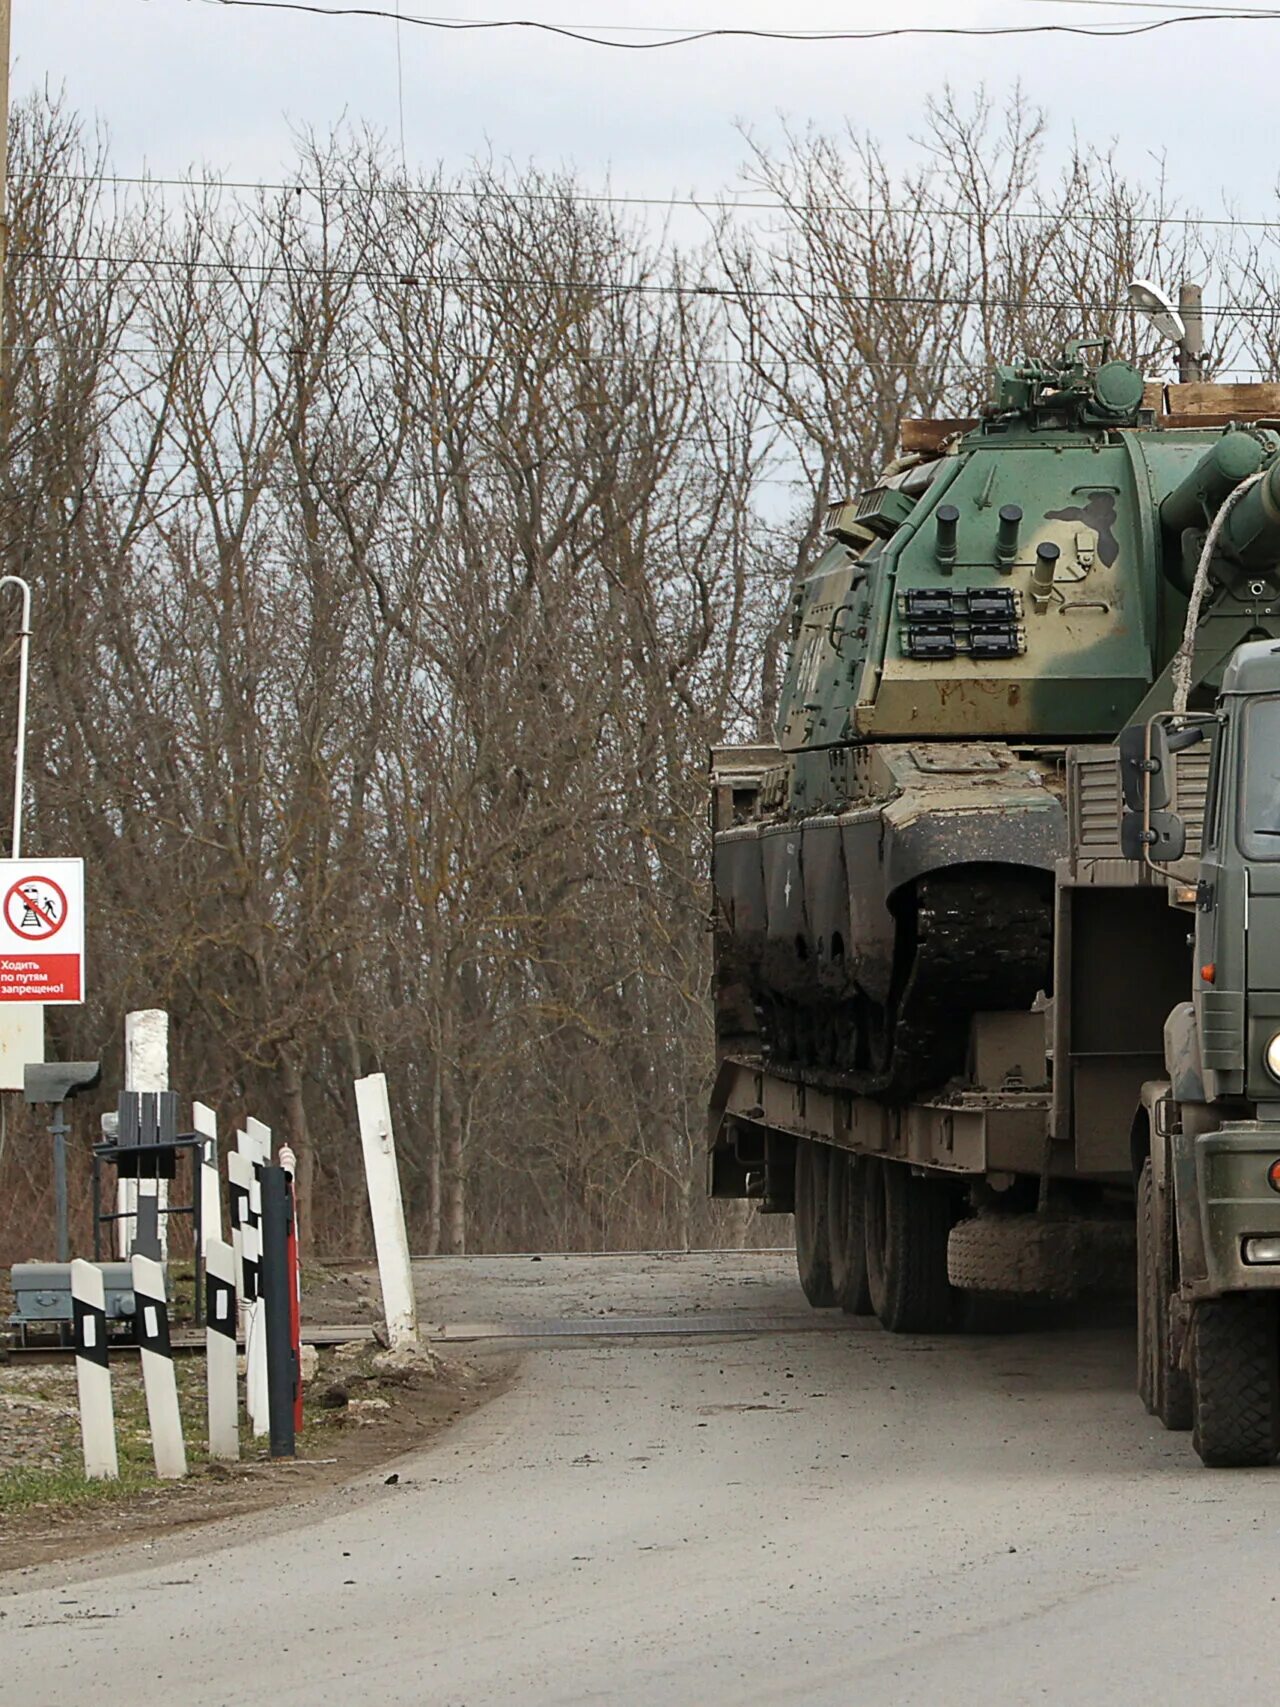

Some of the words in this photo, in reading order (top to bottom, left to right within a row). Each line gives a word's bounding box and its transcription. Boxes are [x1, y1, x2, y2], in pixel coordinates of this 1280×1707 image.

[1, 960, 40, 971] Ходить
[1, 973, 14, 982] по
[16, 973, 48, 984] путям
[1, 983, 64, 995] запрещено!
